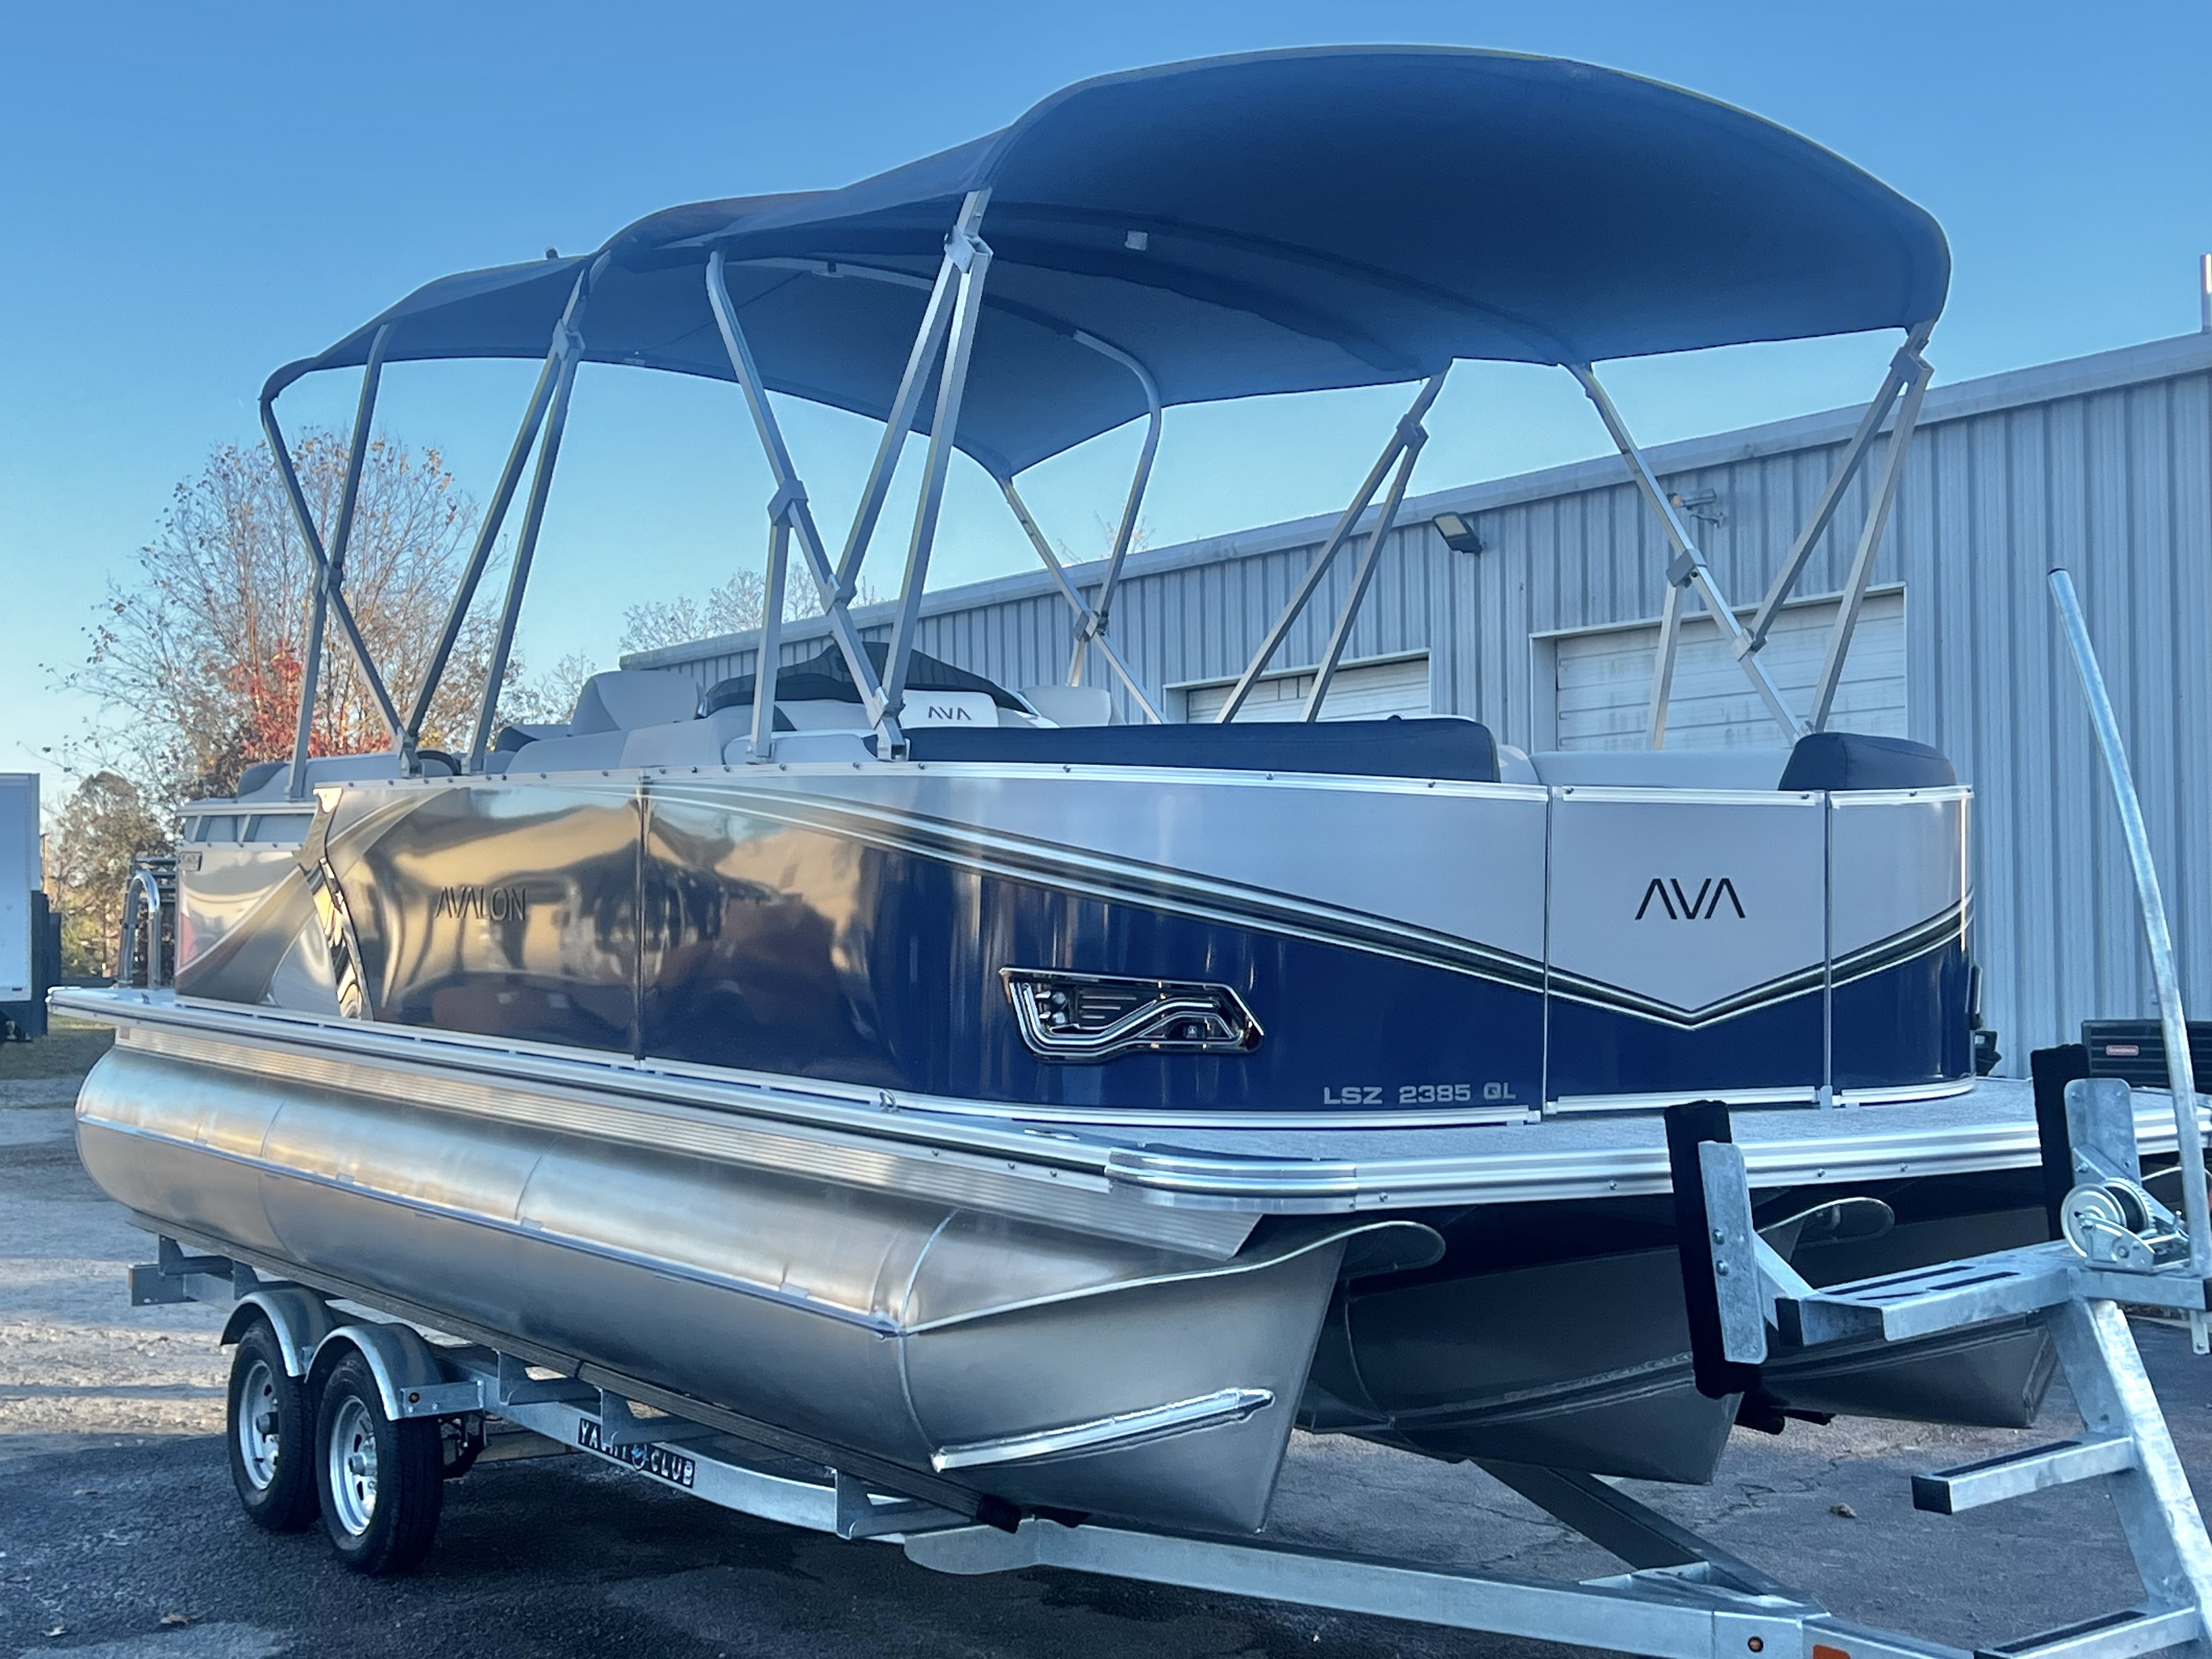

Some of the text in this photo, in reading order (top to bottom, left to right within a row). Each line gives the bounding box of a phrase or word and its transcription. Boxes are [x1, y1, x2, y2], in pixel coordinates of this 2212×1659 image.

[928, 706, 972, 720] AVA
[435, 887, 526, 921] AVALON
[1634, 878, 1746, 920] AVA
[1324, 1082, 1516, 1104] LSZ 2385 QL
[651, 1449, 693, 1486] CLUB
